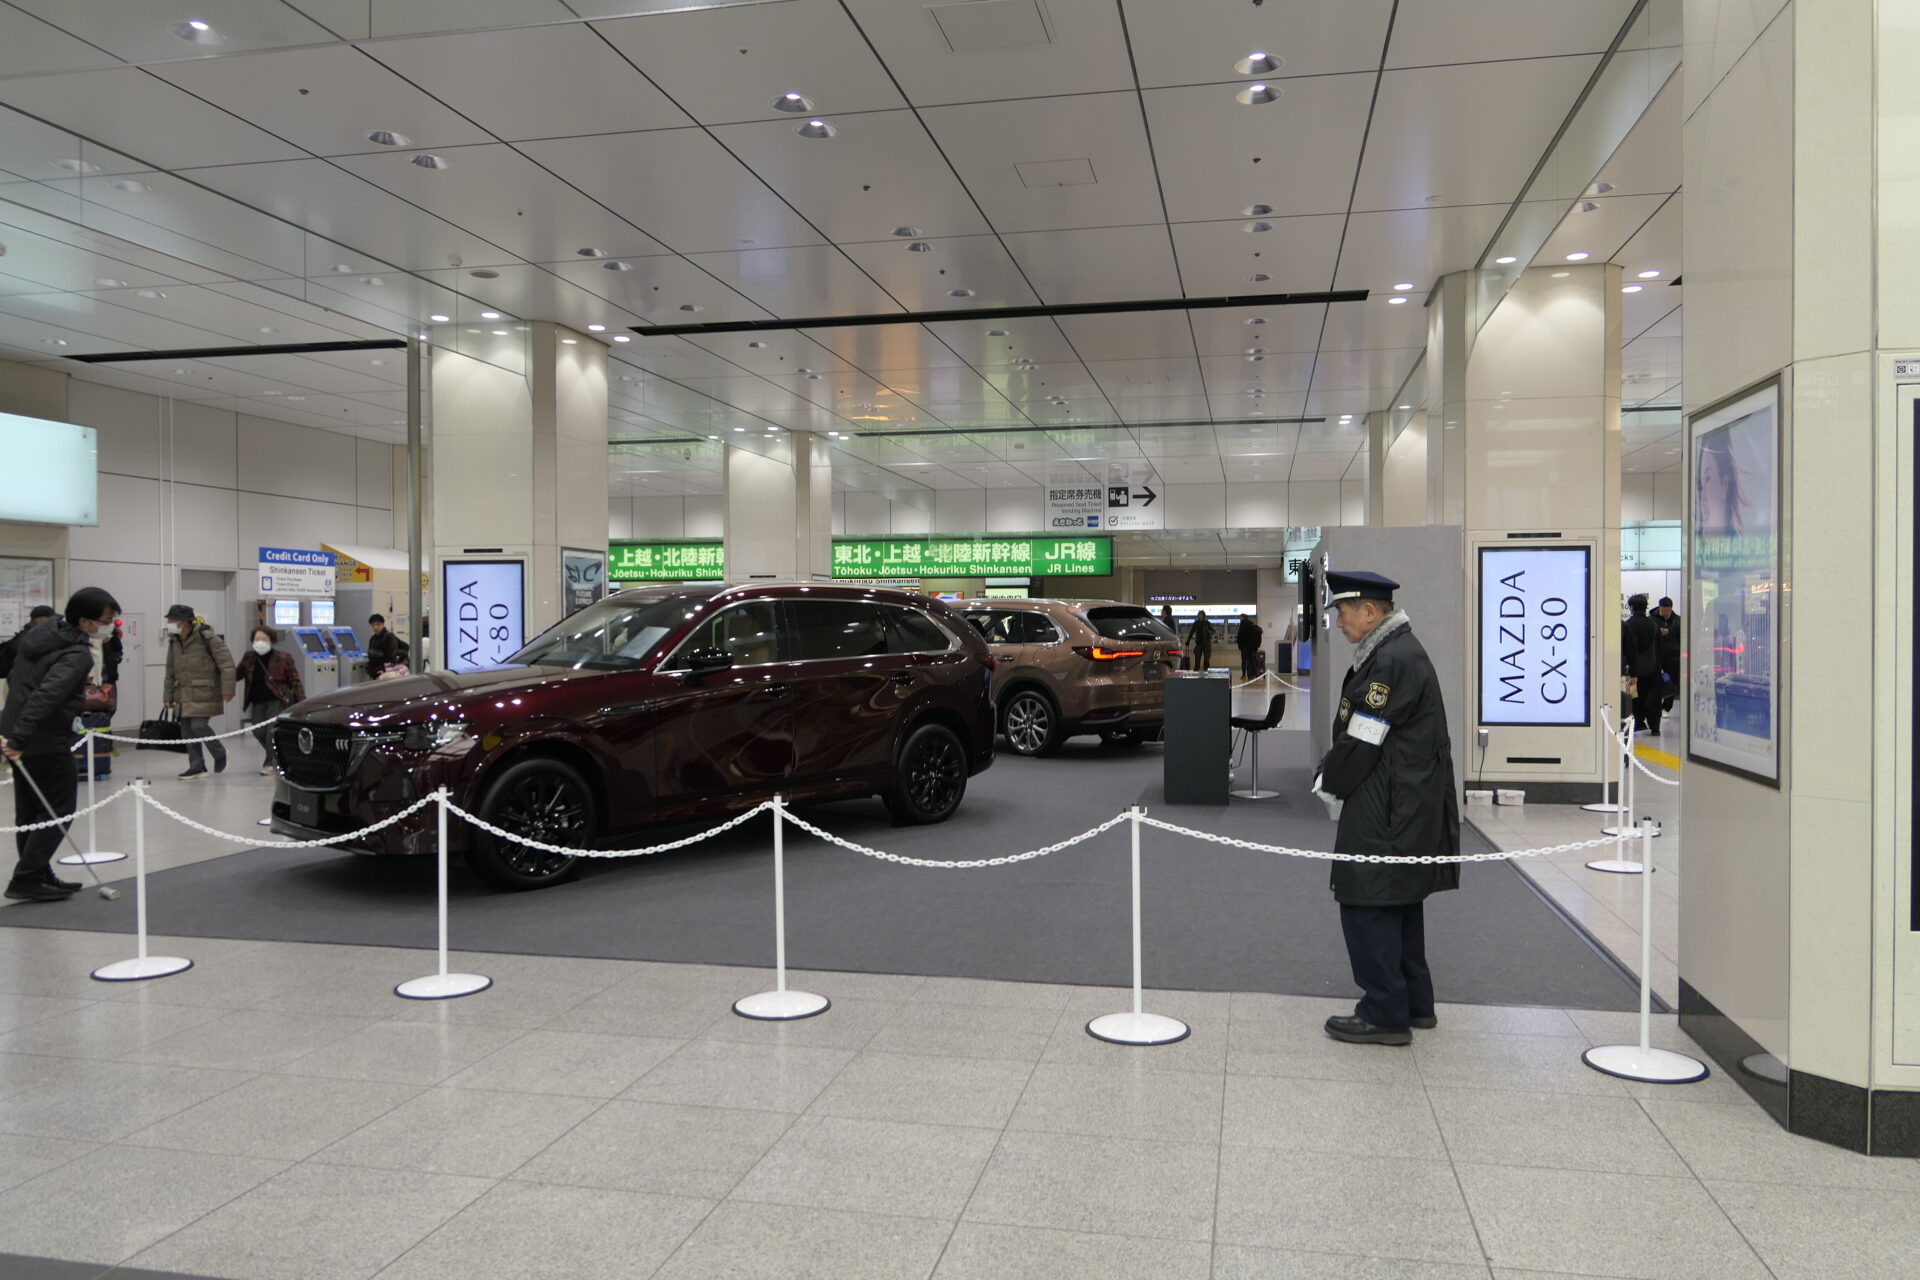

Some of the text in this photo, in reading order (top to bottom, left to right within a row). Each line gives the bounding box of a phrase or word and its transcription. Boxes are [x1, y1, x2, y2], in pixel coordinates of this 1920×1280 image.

[1049, 488, 1102, 500] 指定席券売機
[266, 550, 291, 561] Credit
[292, 552, 311, 562] Card
[312, 554, 329, 566] Only
[1045, 541, 1097, 561] JR線
[269, 566, 326, 577] Shinkansen Ticket
[969, 563, 1031, 575] Shinkansen
[1047, 564, 1061, 574] JR
[1064, 563, 1095, 574] Lines
[458, 580, 479, 667] AZDA
[1499, 569, 1526, 704] MAZDA
[1540, 596, 1568, 705] CX-80
